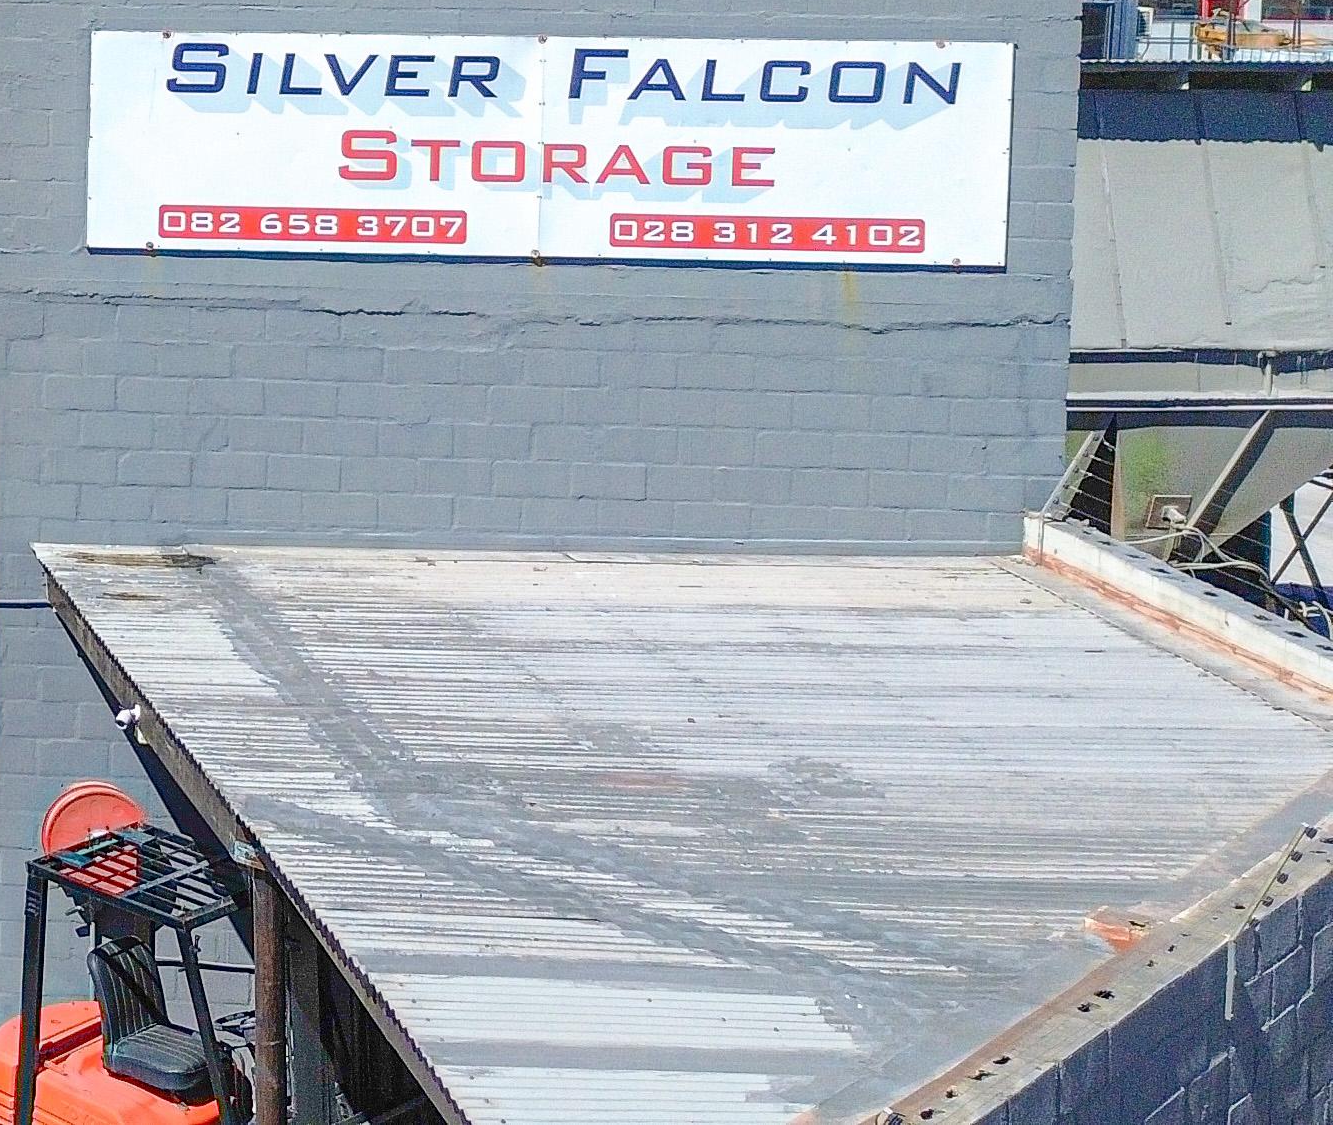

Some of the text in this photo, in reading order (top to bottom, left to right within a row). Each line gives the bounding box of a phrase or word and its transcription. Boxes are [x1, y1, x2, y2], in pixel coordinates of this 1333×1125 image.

[166, 43, 961, 105] SILVER FALCON
[339, 129, 775, 187] STORAGE
[162, 211, 463, 238] 082 658 3707
[613, 220, 921, 247] 028 312 4102
